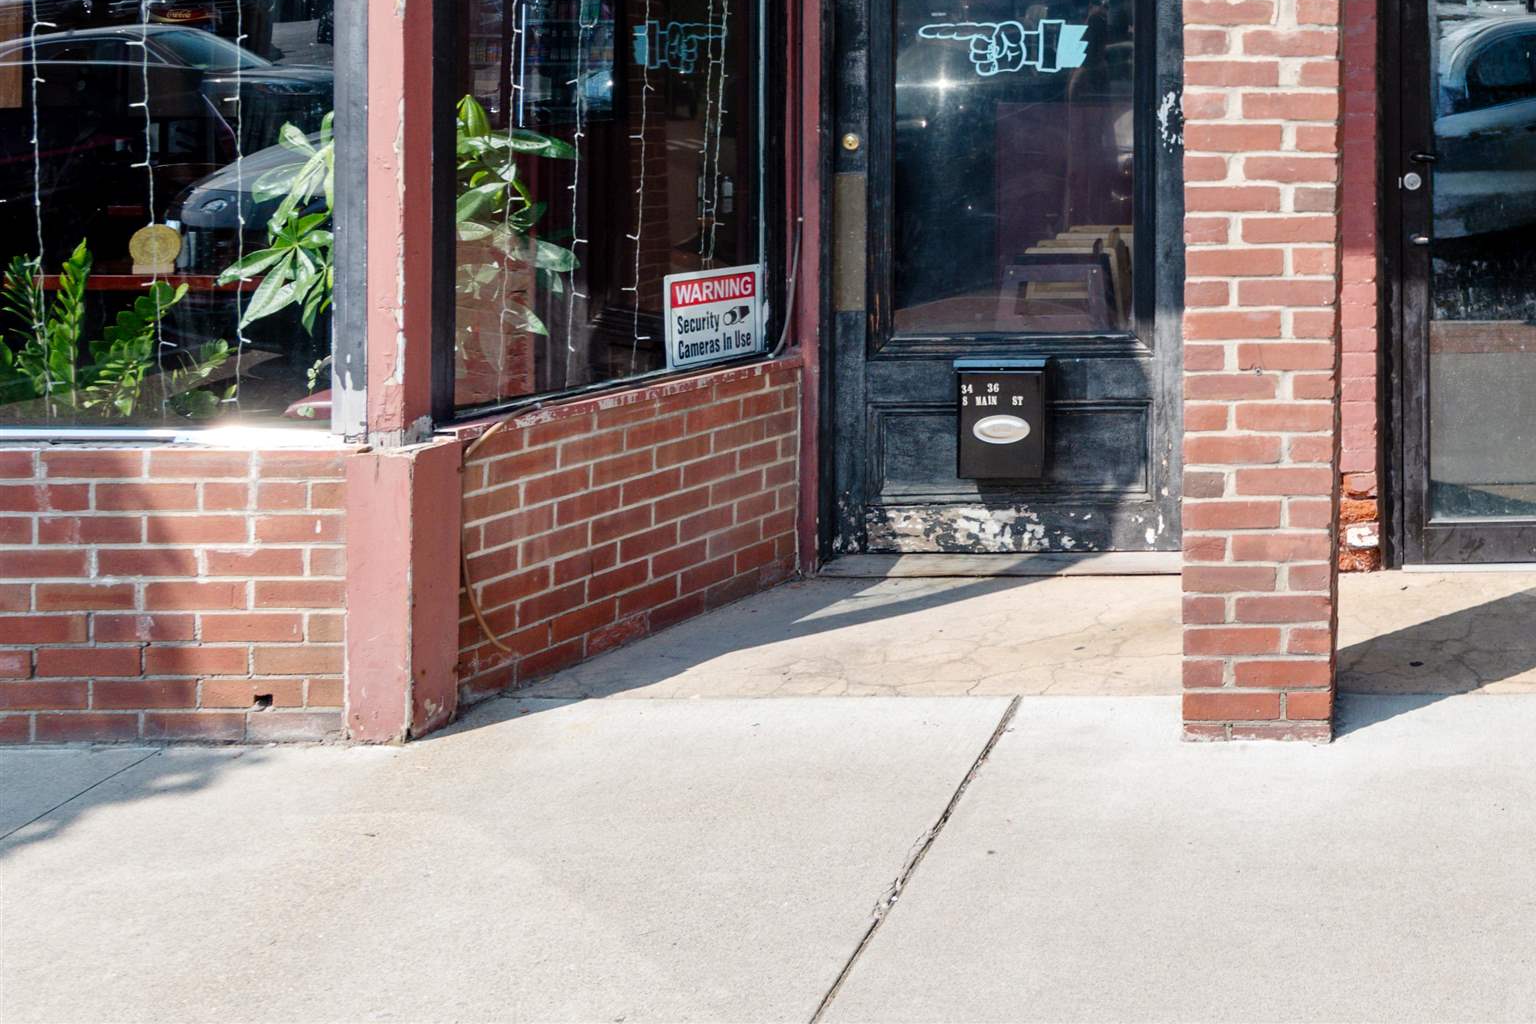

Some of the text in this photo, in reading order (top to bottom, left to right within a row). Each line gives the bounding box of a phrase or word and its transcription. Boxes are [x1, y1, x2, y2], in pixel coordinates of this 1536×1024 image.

[675, 276, 752, 305] WARNING
[677, 311, 720, 335] Security
[678, 329, 752, 360] Cameras In Use
[960, 382, 1000, 394] 34 36
[961, 395, 1024, 406] S MAIN ST
